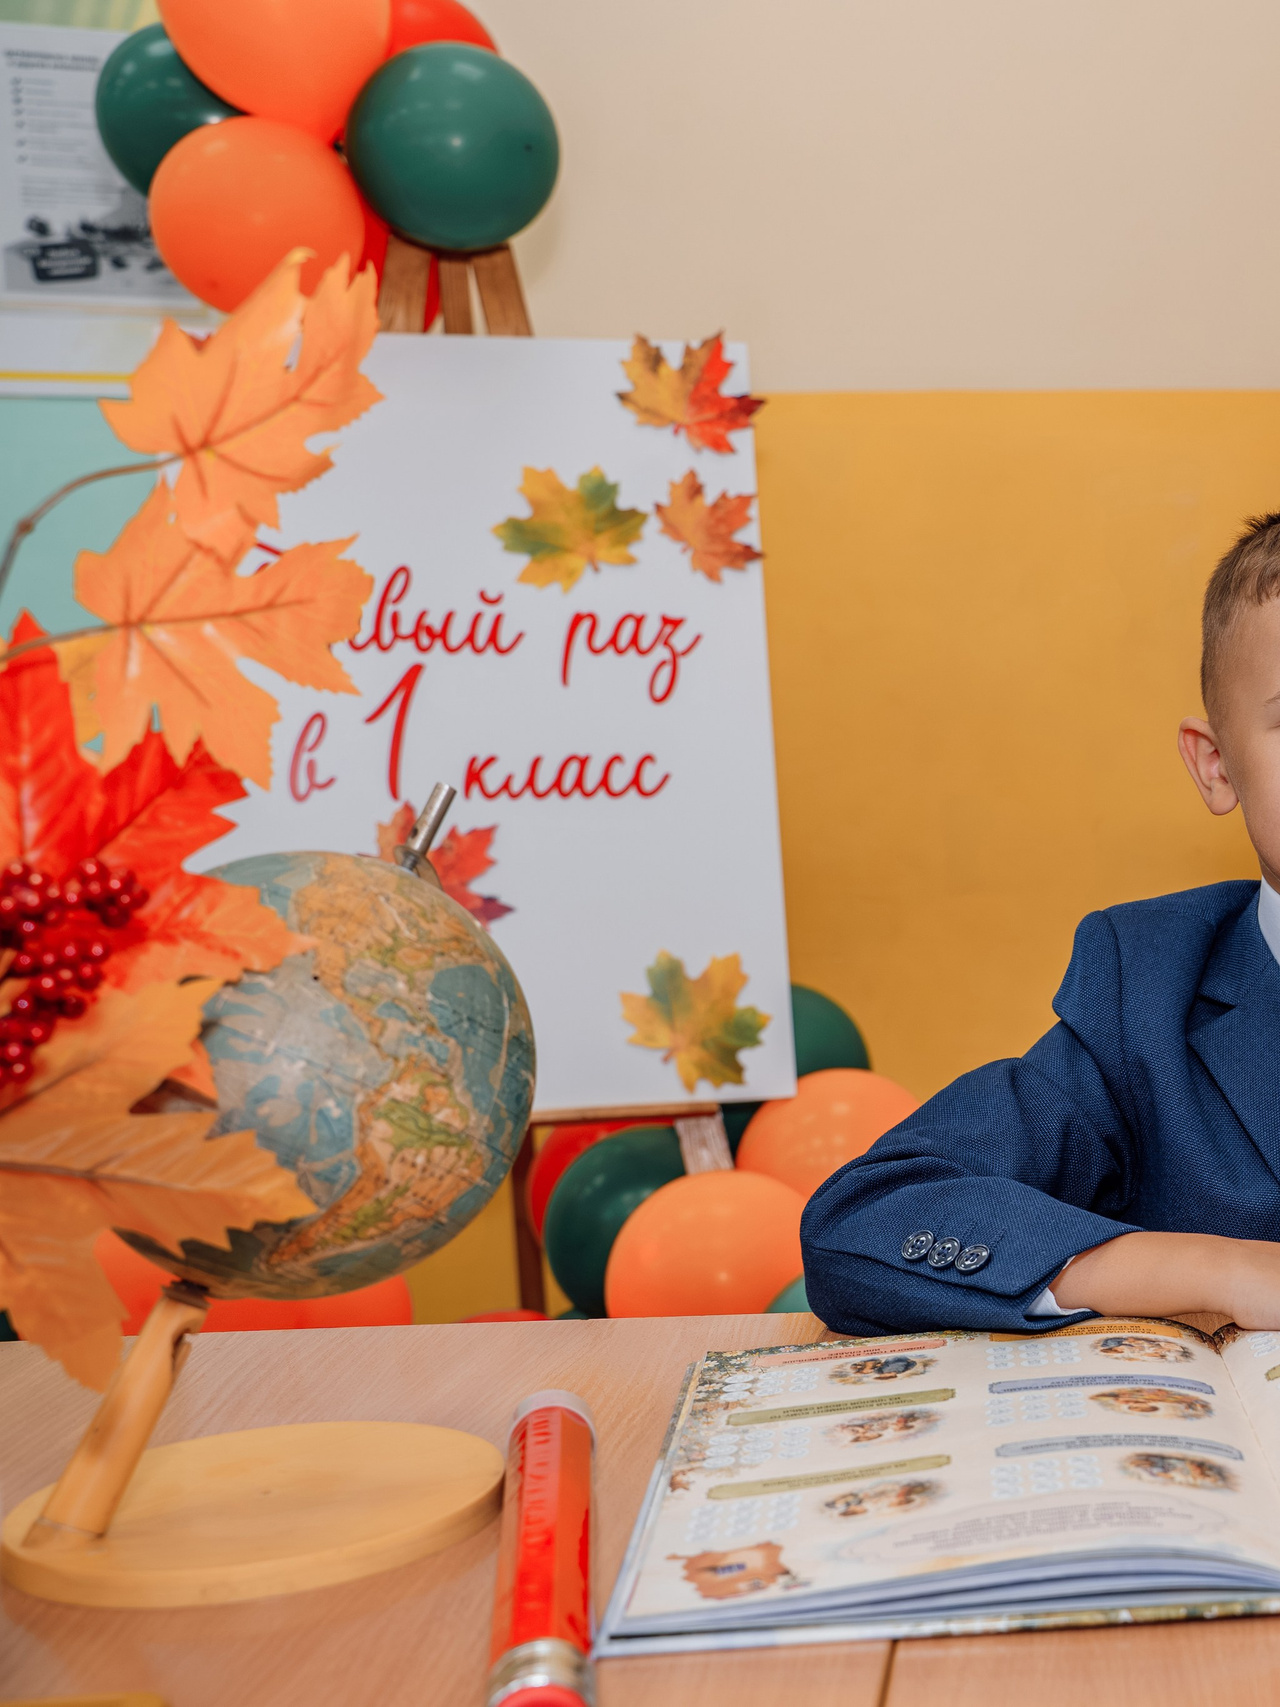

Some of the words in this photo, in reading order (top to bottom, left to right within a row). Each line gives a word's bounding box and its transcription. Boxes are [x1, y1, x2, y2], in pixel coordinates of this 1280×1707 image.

[560, 611, 703, 704] раз
[288, 711, 337, 803] в
[363, 662, 426, 802] 1
[462, 752, 672, 800] класс
